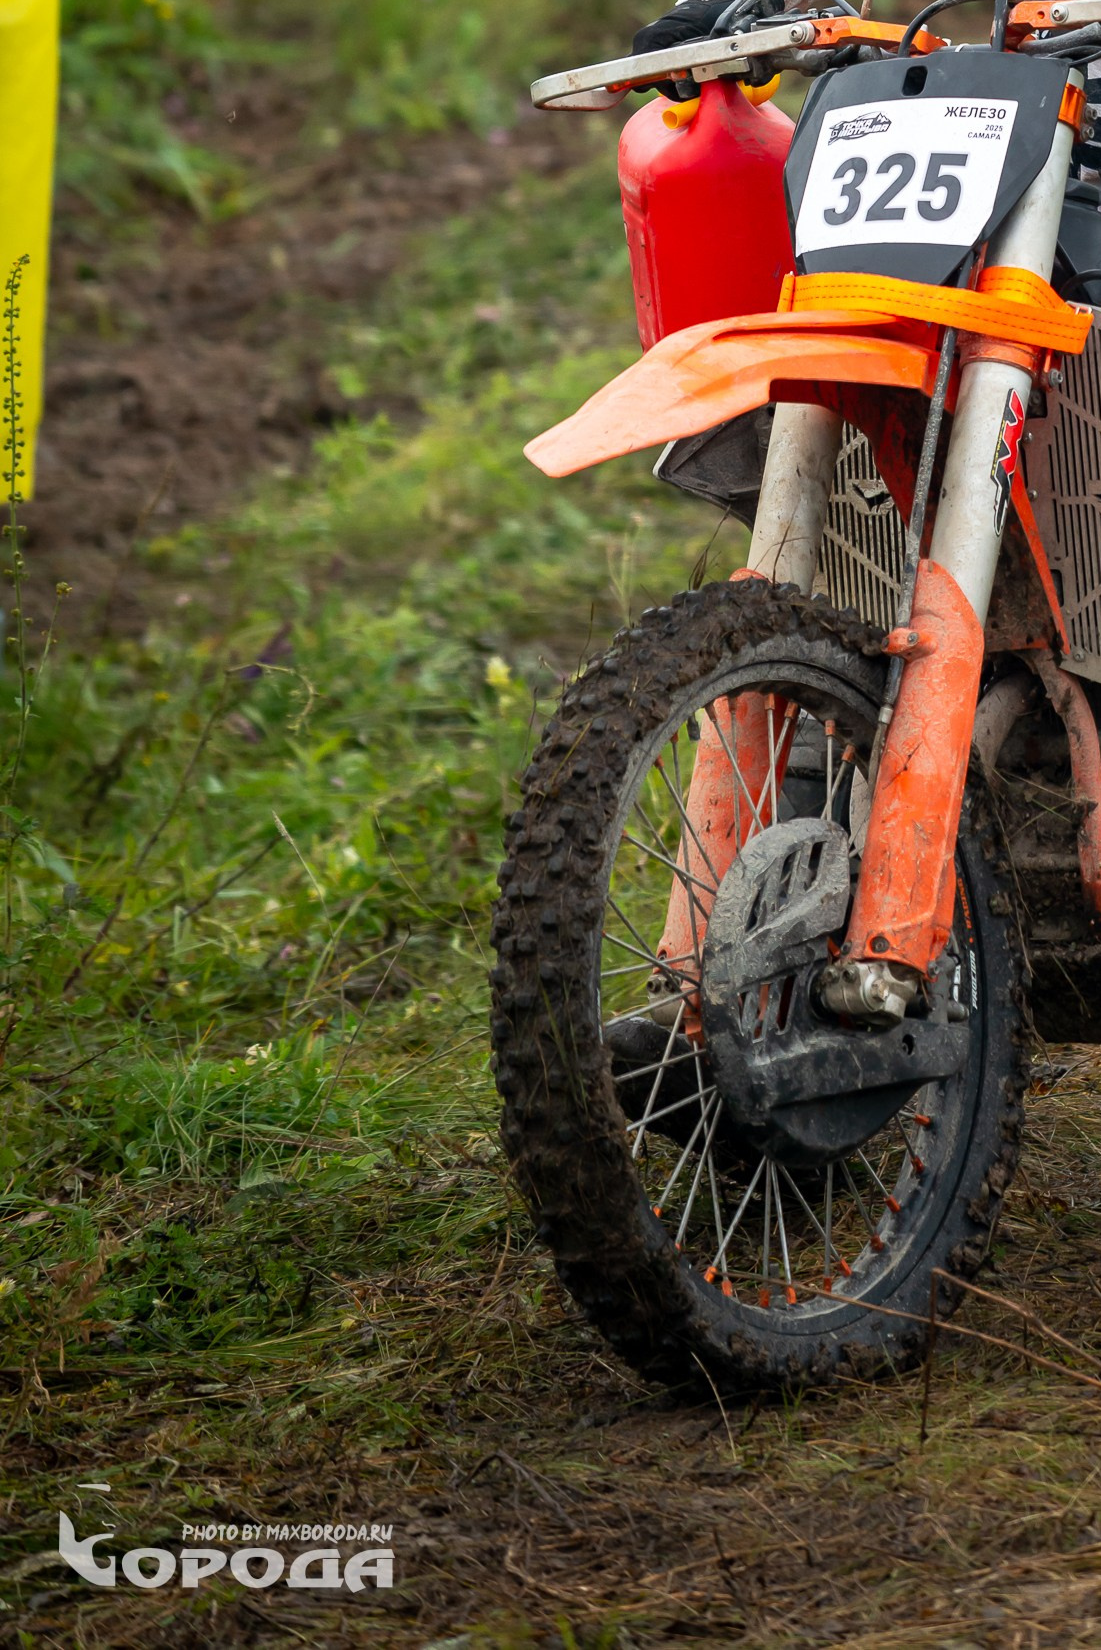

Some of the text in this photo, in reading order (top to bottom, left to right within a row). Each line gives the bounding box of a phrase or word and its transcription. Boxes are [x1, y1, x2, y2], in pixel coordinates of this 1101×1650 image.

[944, 106, 1007, 120] ЖЕЛЕЗО
[984, 124, 1003, 132] 2025
[967, 131, 1002, 141] САМАРА
[823, 152, 969, 226] 325
